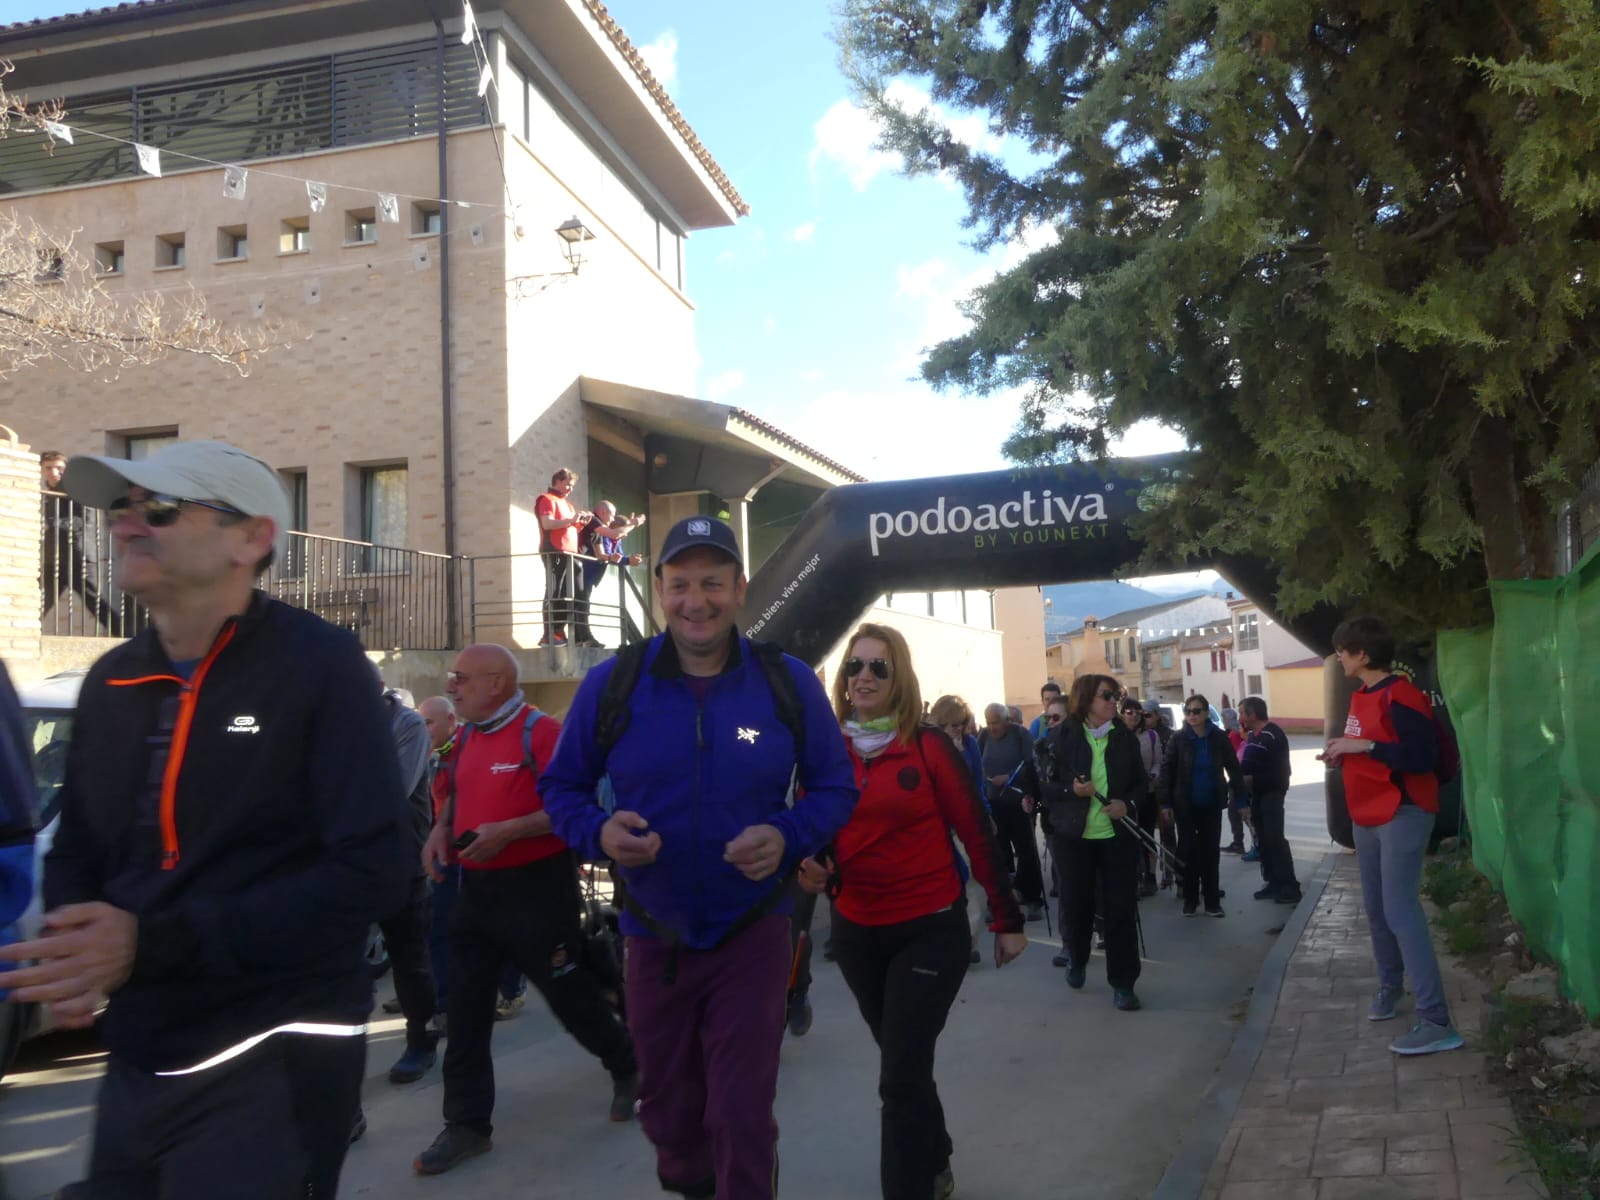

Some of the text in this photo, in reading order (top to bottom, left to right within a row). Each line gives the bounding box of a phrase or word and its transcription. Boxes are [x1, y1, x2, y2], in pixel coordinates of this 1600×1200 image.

[869, 489, 1108, 557] podoactiva
[973, 522, 1109, 549] BY YOUNEXT
[745, 553, 821, 639] Pisa bien, vive mejor
